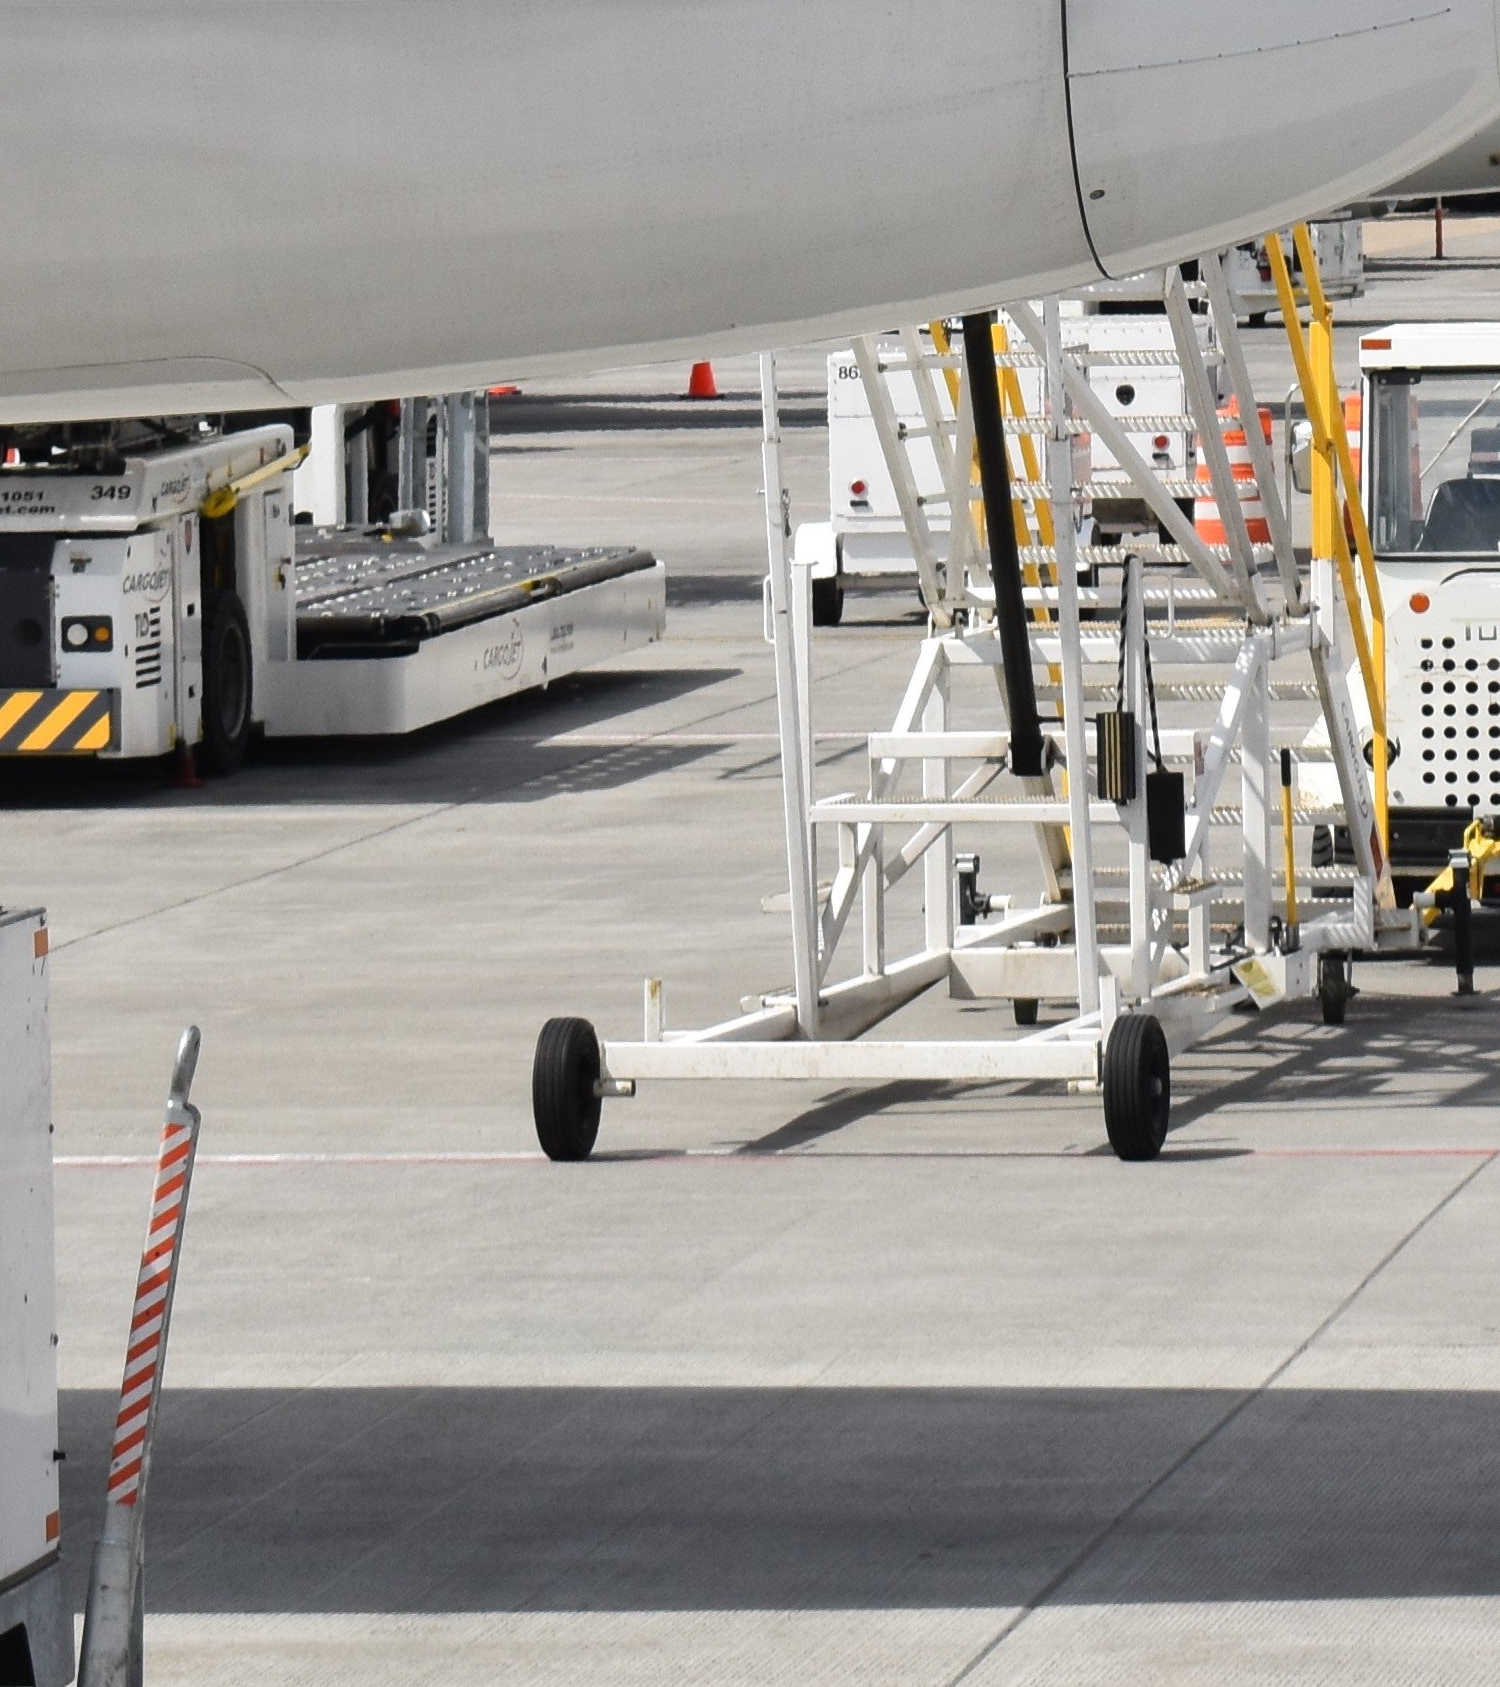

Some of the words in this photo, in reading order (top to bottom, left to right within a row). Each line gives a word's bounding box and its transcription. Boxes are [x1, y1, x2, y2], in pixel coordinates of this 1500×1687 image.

[838, 365, 863, 380] 86
[90, 484, 132, 501] 349
[122, 569, 172, 595] CARGOJET
[1341, 701, 1368, 819] CARGOJET
